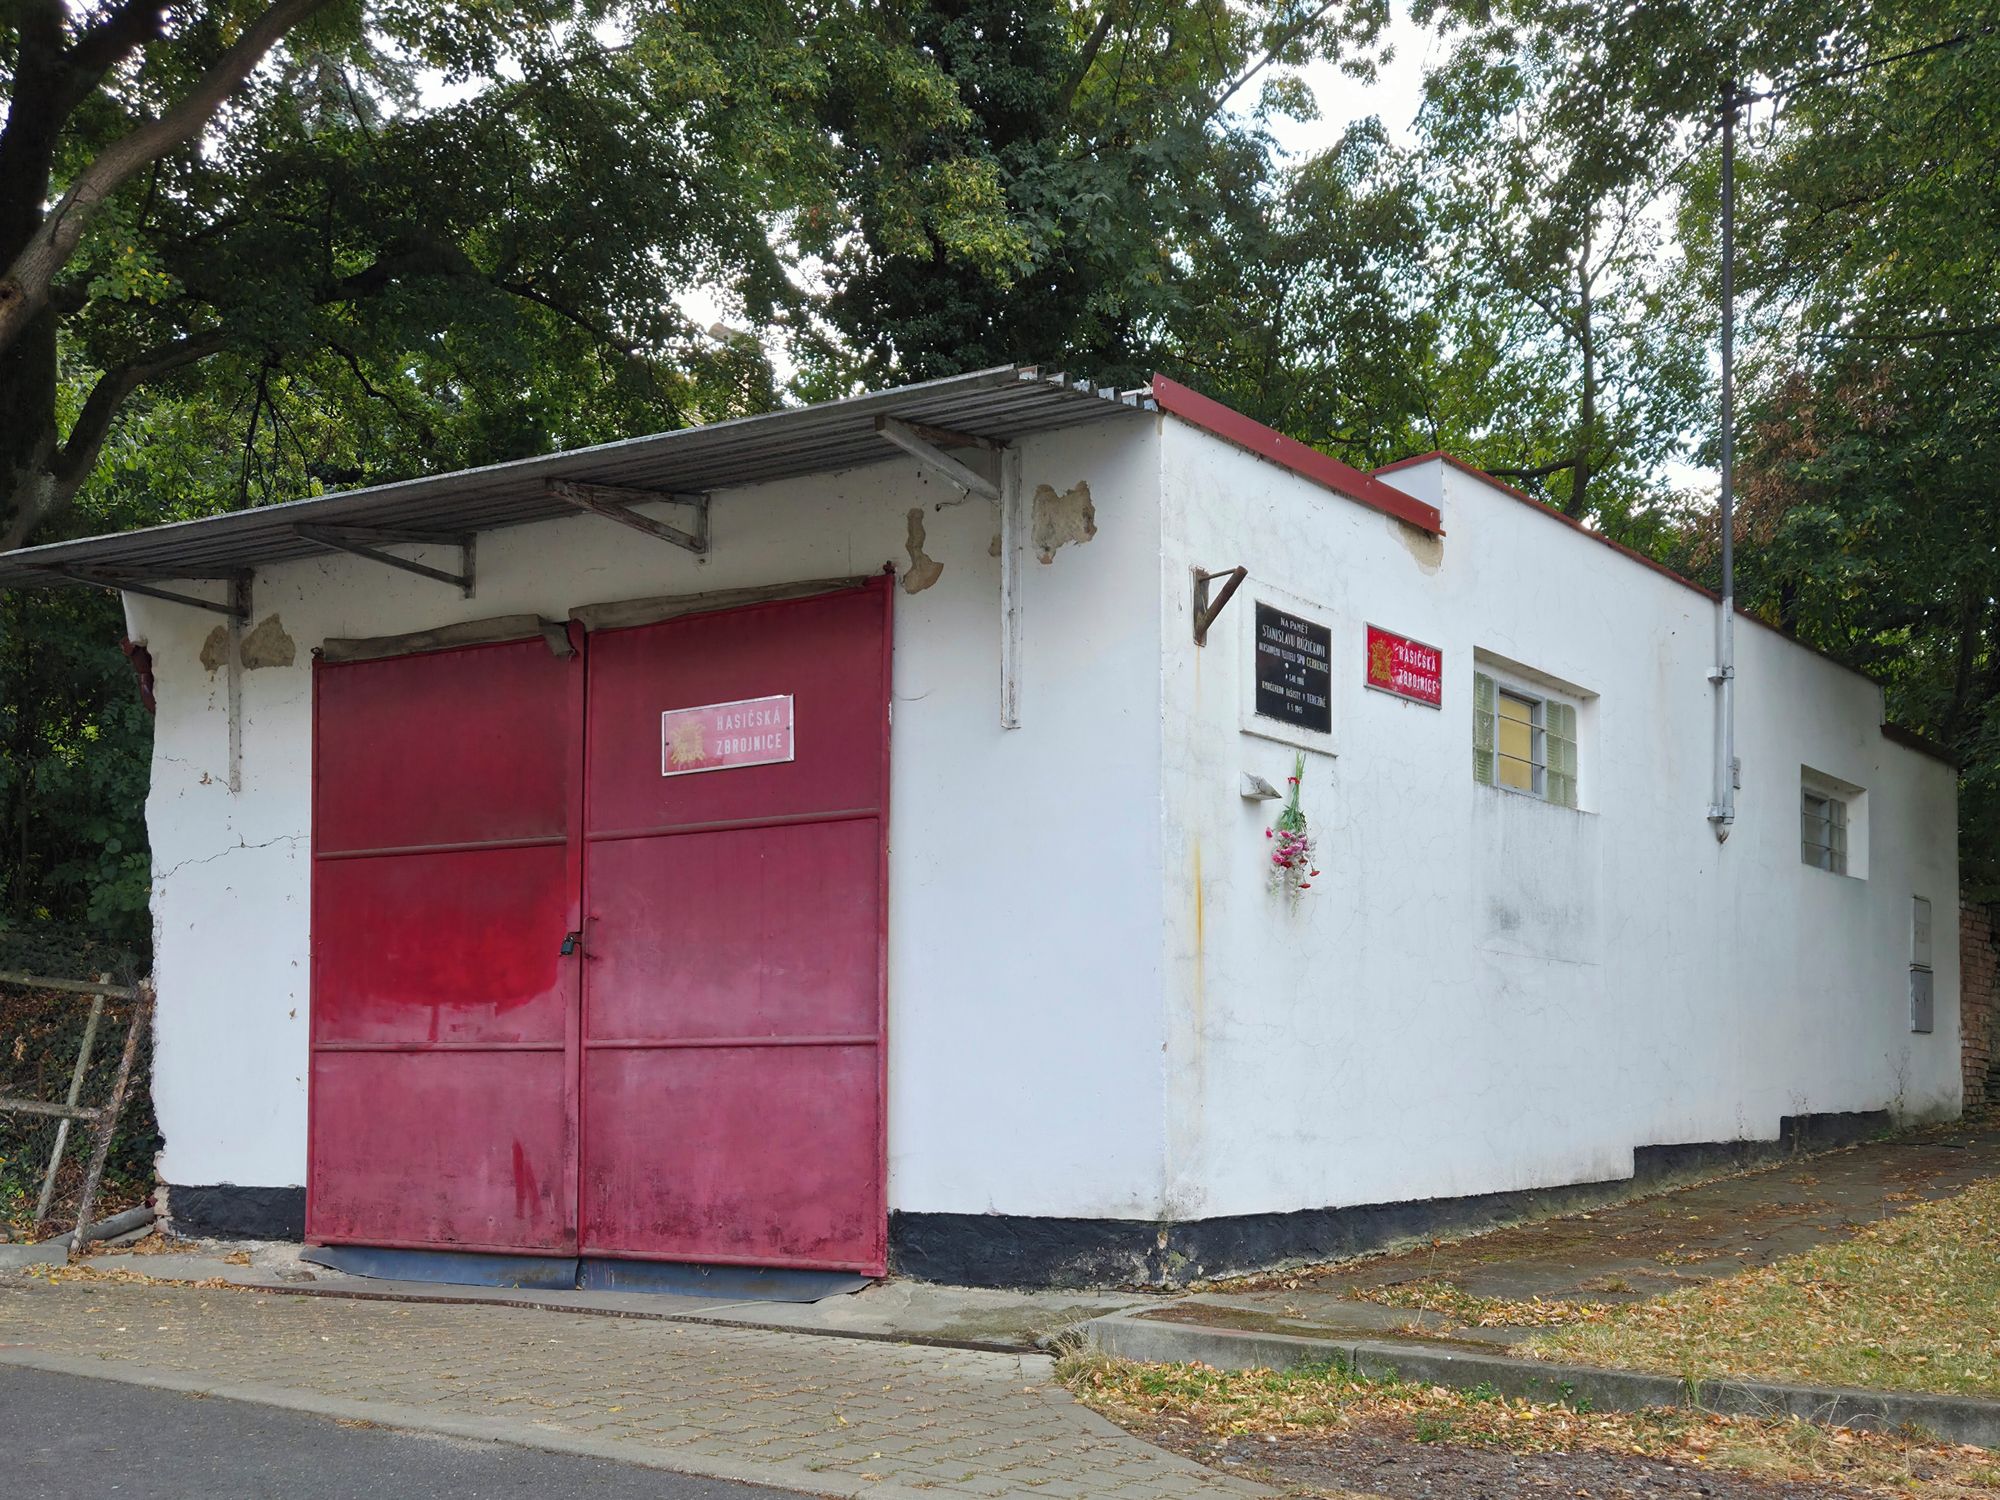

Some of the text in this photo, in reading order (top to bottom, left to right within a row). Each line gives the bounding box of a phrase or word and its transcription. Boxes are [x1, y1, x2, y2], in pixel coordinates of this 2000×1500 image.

[1280, 617, 1289, 628] NA
[1262, 624, 1296, 648] STANISLAVU
[1398, 645, 1437, 672] HASIČSKÁ
[1398, 668, 1437, 695] ZBROJNICE
[716, 706, 781, 731] HASIČSKÁ
[716, 733, 782, 756] ZBROJNICE
